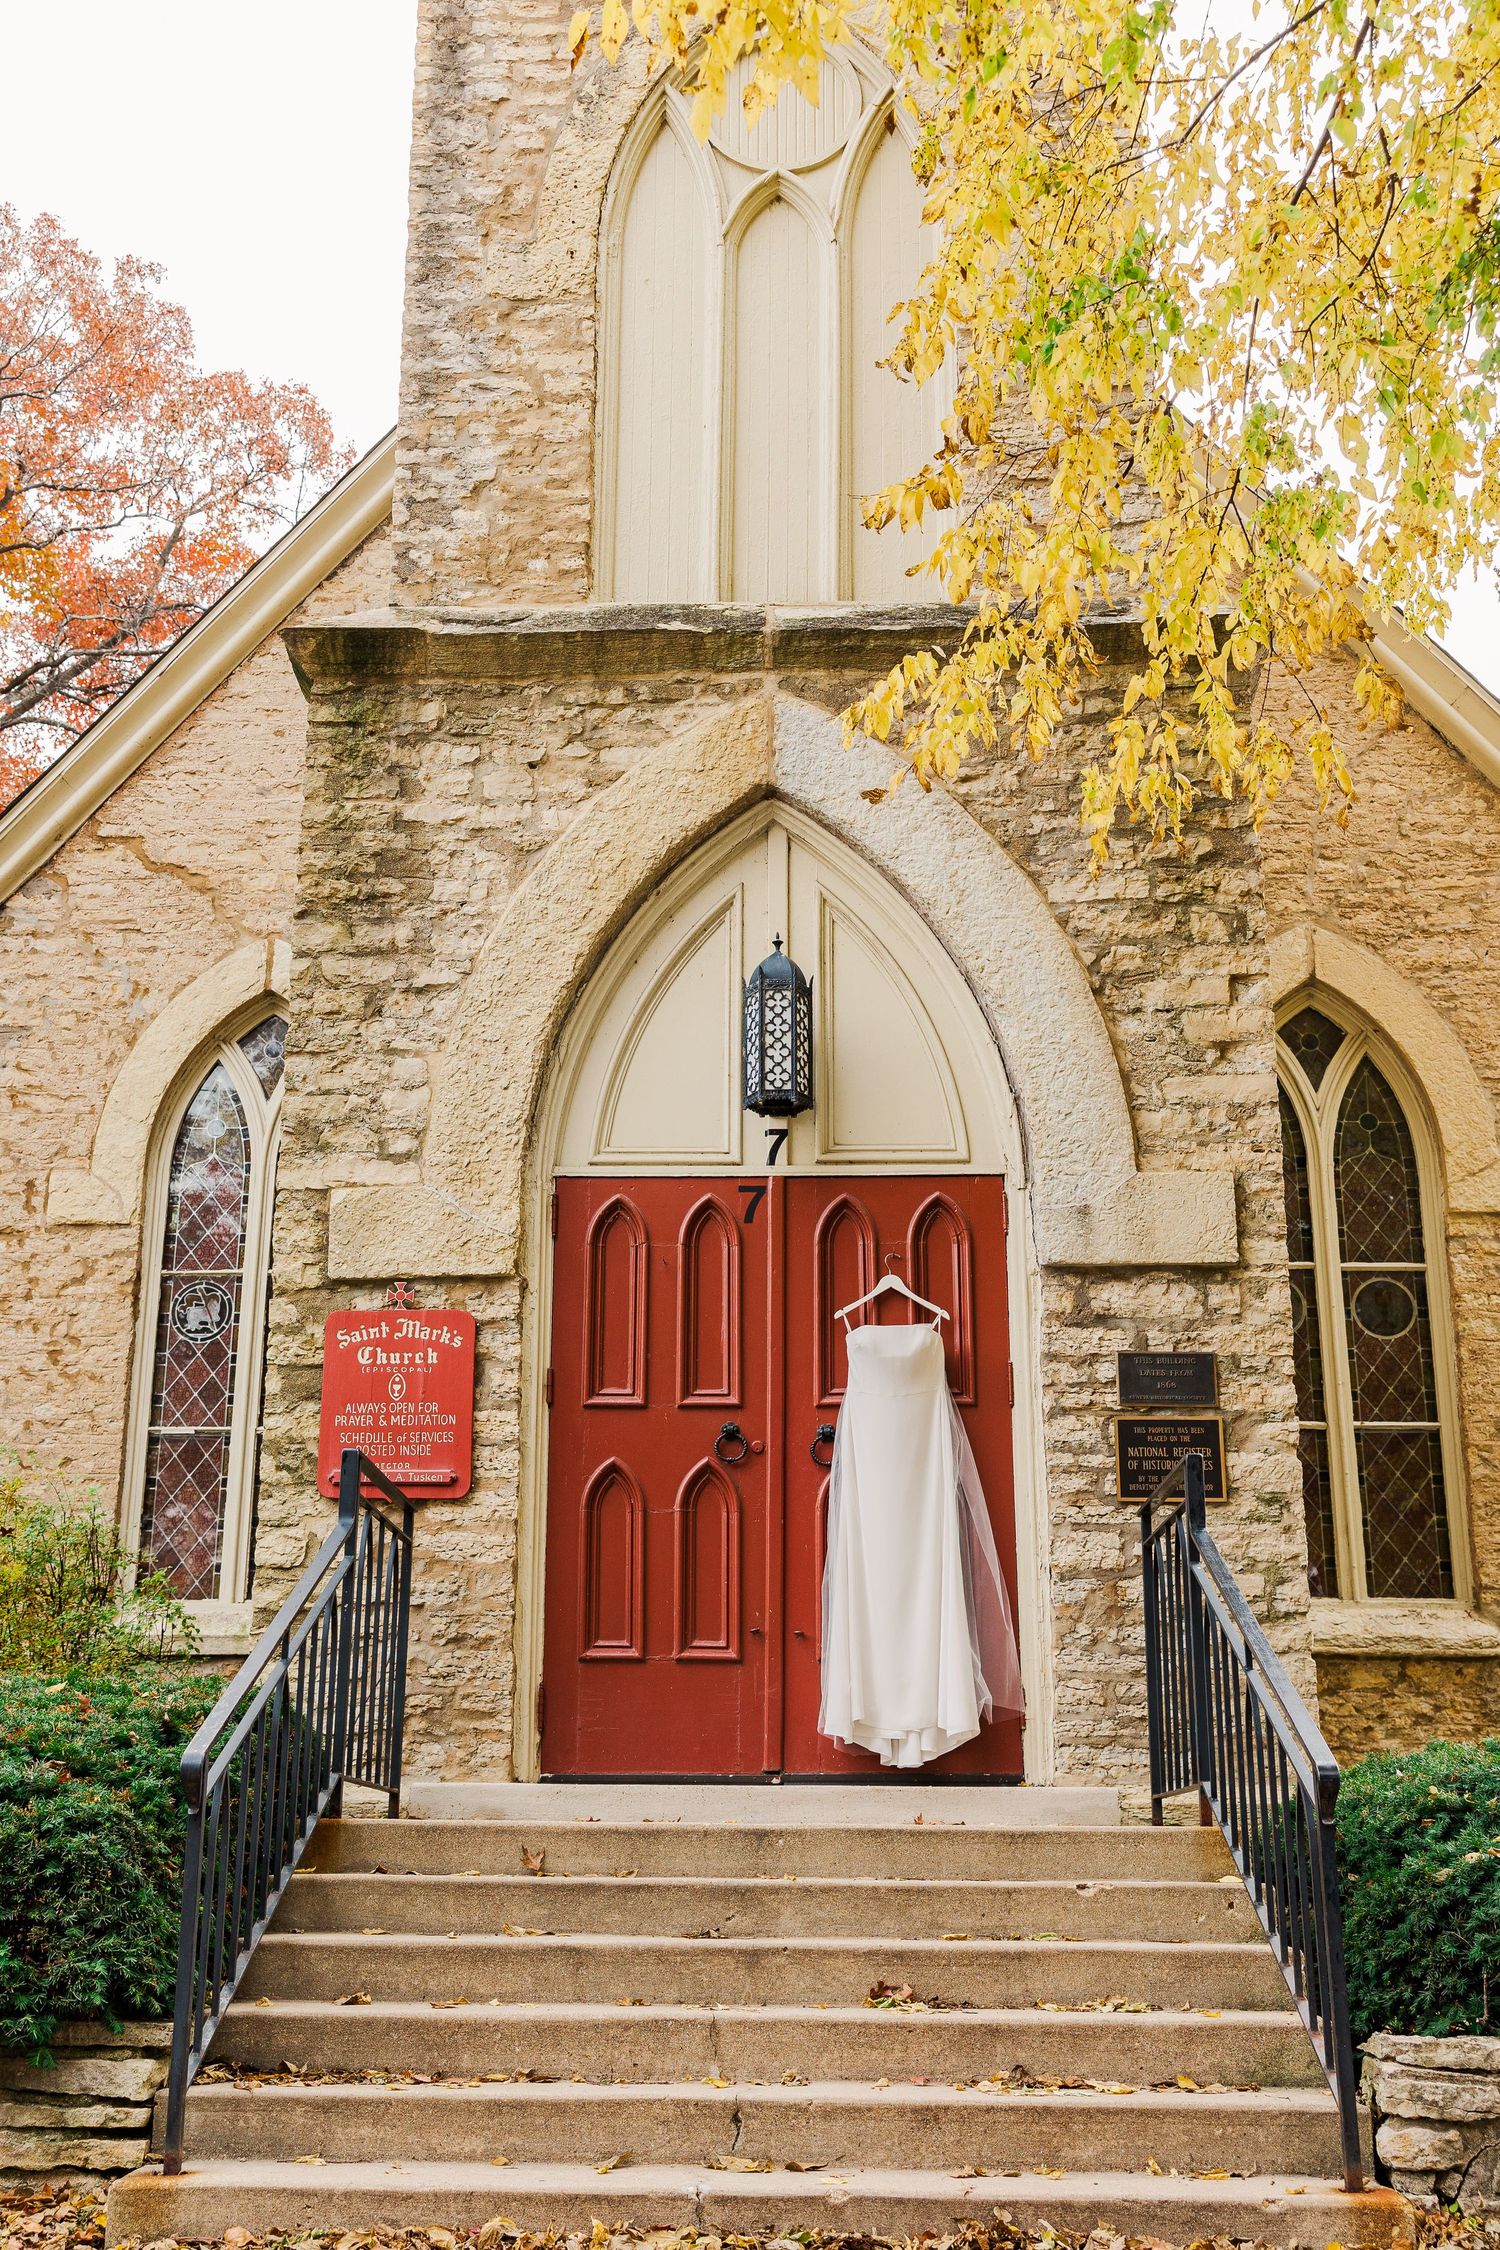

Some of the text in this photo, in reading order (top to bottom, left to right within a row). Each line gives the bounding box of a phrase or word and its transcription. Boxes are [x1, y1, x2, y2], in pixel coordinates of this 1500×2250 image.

[765, 1129, 789, 1166] 7
[738, 1185, 768, 1224] 7
[336, 1318, 464, 1349] Saint Mark's
[357, 1347, 439, 1365] Church
[1156, 1357, 1197, 1365] BUILDING
[361, 1366, 432, 1374] (EPISCOPAL)
[345, 1402, 439, 1414] ALWAYS OPEN FOR
[334, 1414, 456, 1427] PRAYER & MEDITATION
[1133, 1426, 1205, 1434] THIS PROPERTY HAS BEEN
[339, 1431, 454, 1444] SCHEDULE of SERVICES
[399, 1444, 432, 1456] INSIDE
[1127, 1446, 1212, 1457] NATIONAL REGISTER
[1127, 1460, 1139, 1470] OF
[408, 1472, 443, 1482] Tusken
